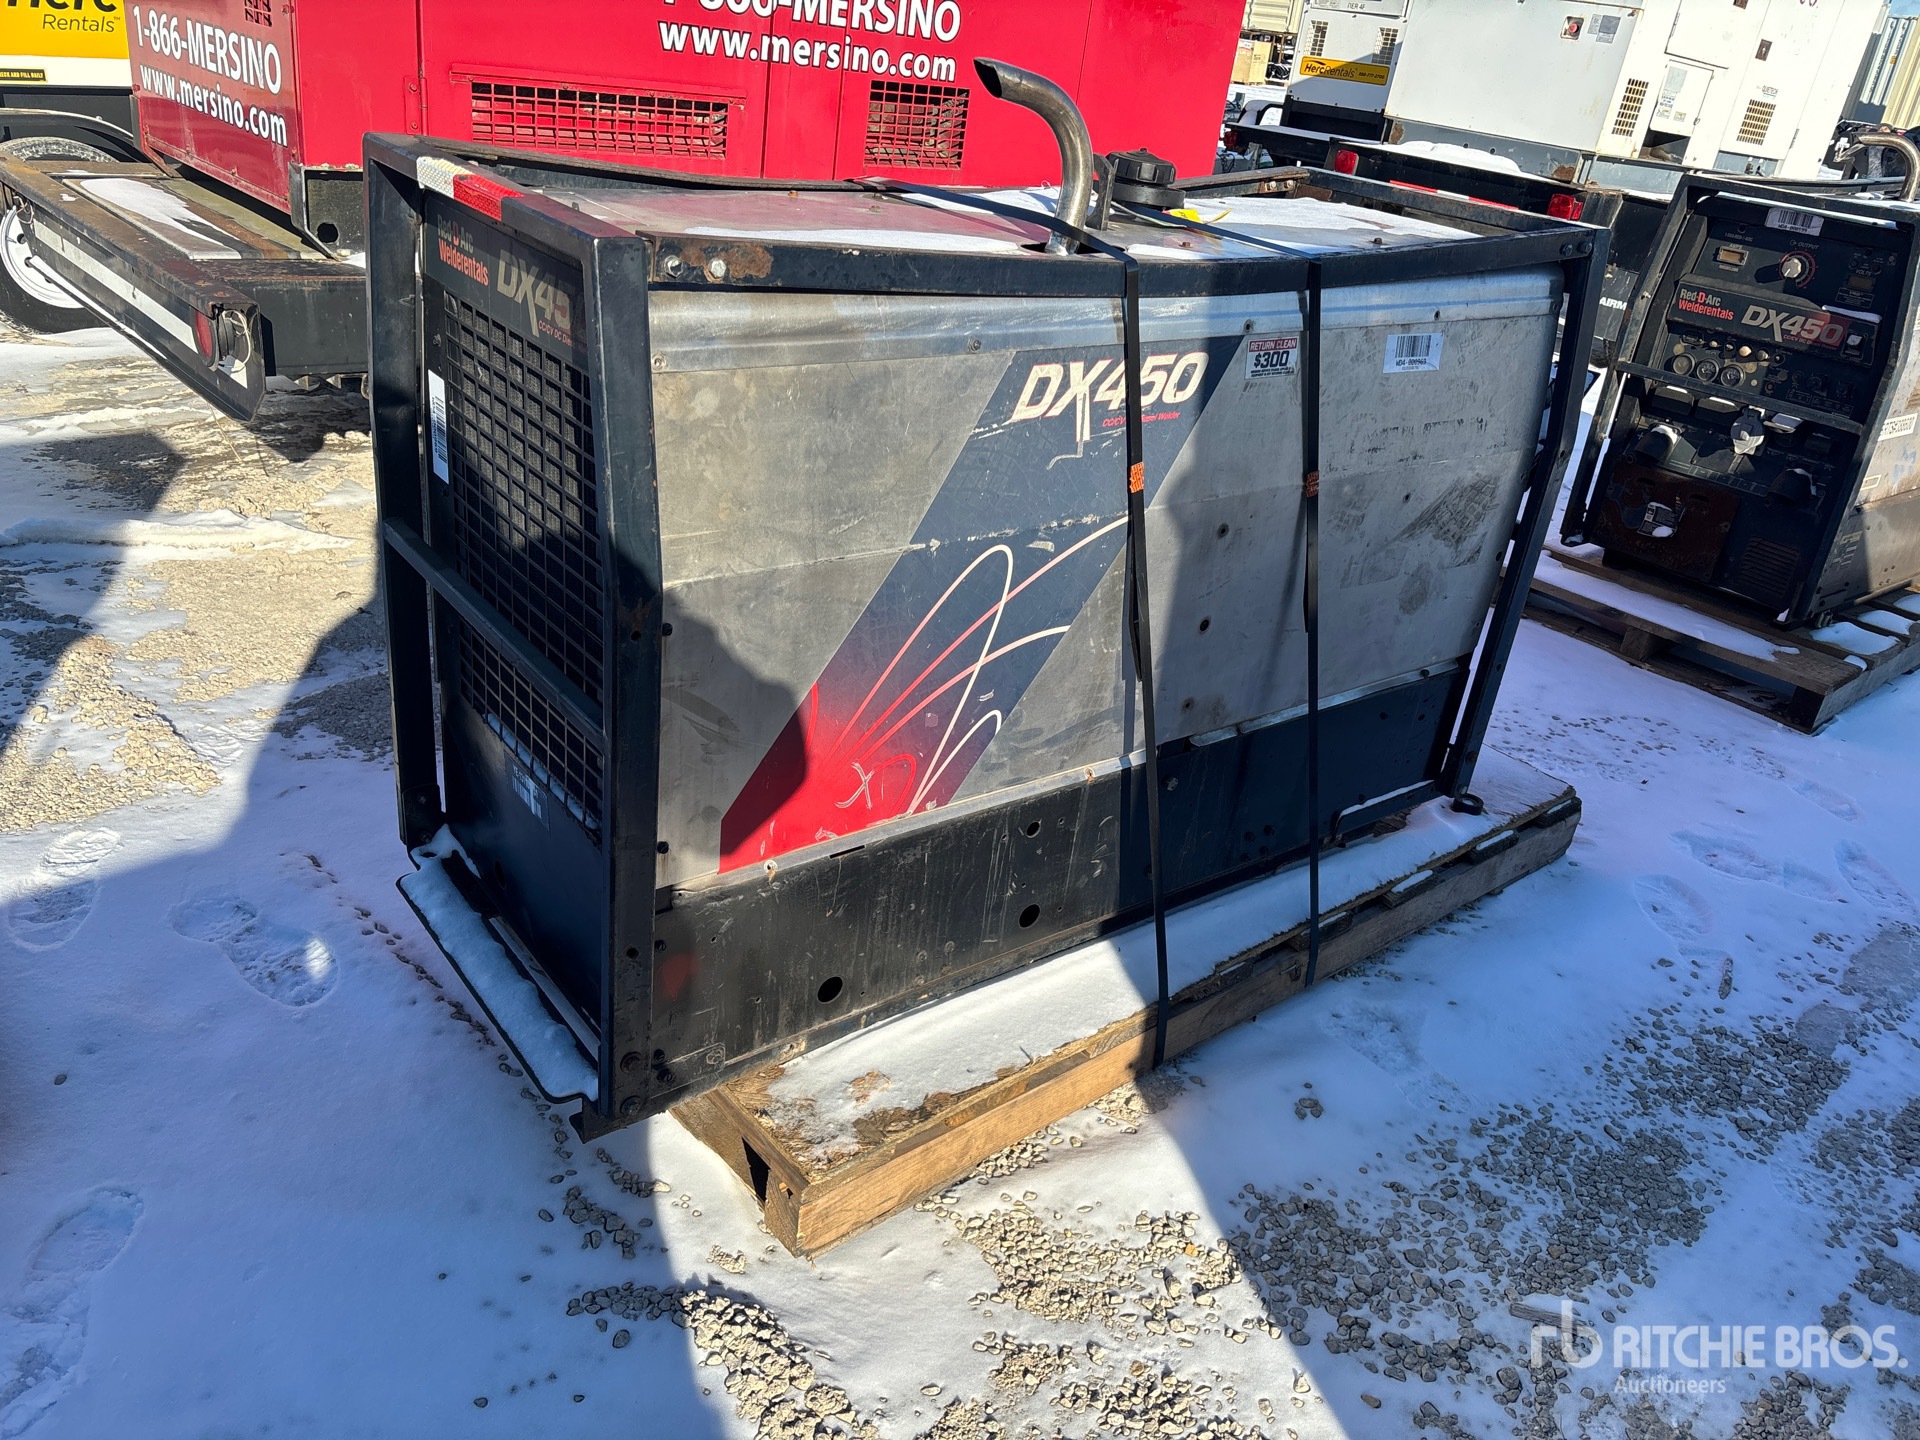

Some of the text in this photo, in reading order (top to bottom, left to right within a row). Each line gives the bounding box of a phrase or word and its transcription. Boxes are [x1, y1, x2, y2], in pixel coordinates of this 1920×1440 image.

[133, 5, 282, 94] 1-866-MERSINO
[657, 20, 957, 82] www.mersino.com
[139, 64, 288, 147] www.mersino.com
[438, 238, 489, 286] Welderentals
[1798, 241, 1820, 250] OUTPUT
[1855, 269, 1872, 277] VOLTS
[1678, 299, 1735, 321] Welderentals
[1741, 304, 1844, 345] DX450
[1250, 339, 1297, 351] RETURN CLEAN
[1253, 350, 1290, 368] $300
[1010, 351, 1210, 444] DX450
